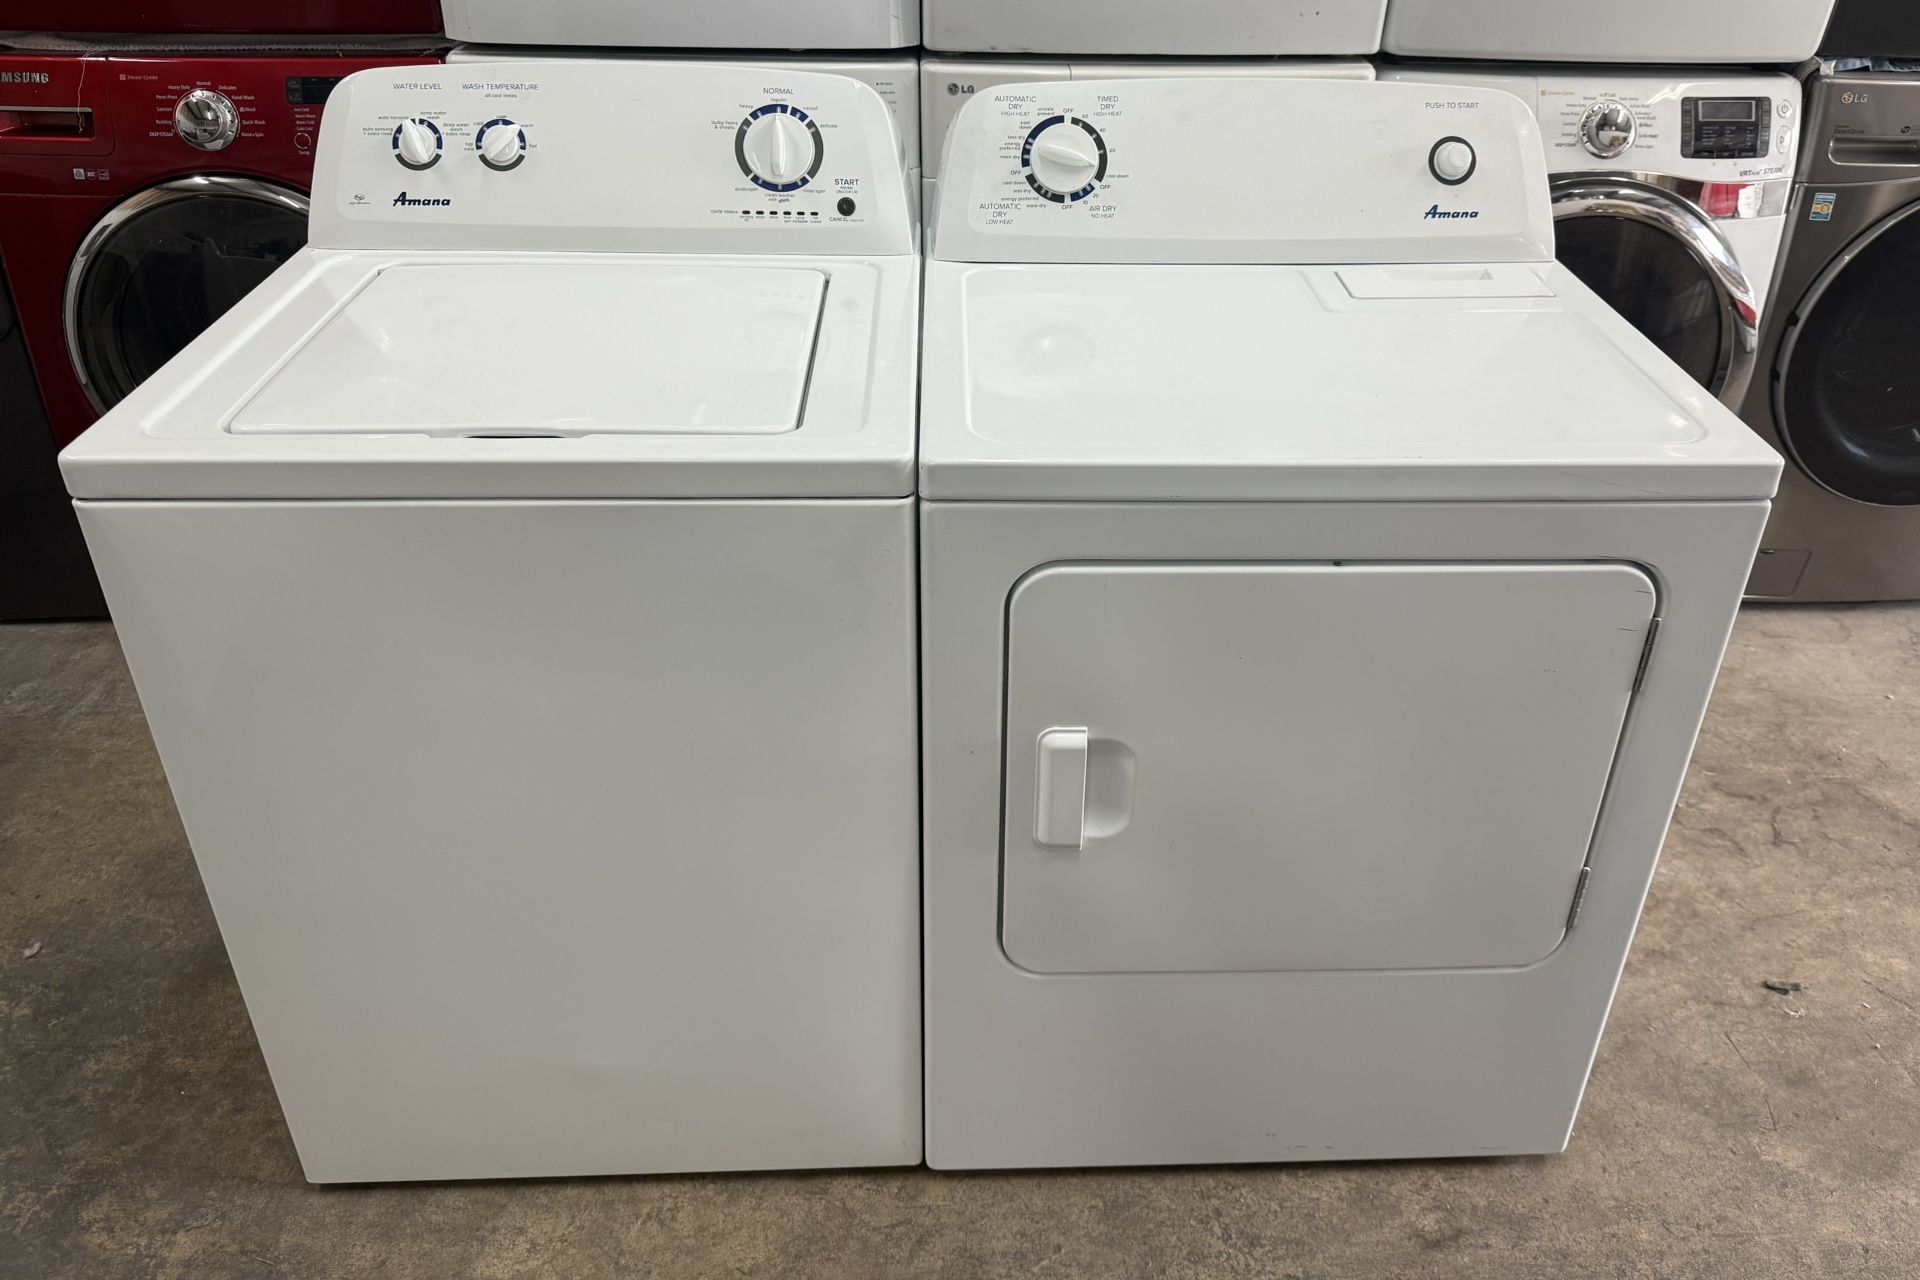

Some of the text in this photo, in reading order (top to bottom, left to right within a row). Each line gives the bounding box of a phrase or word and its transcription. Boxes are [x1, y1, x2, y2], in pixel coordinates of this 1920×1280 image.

[0, 71, 49, 83] MSUNG
[961, 85, 975, 94] LG
[994, 95, 1037, 103] AUTOMATIC
[1854, 93, 1868, 103] LG
[834, 178, 860, 186] START
[392, 191, 451, 207] Amana
[1423, 204, 1480, 220] Amana
